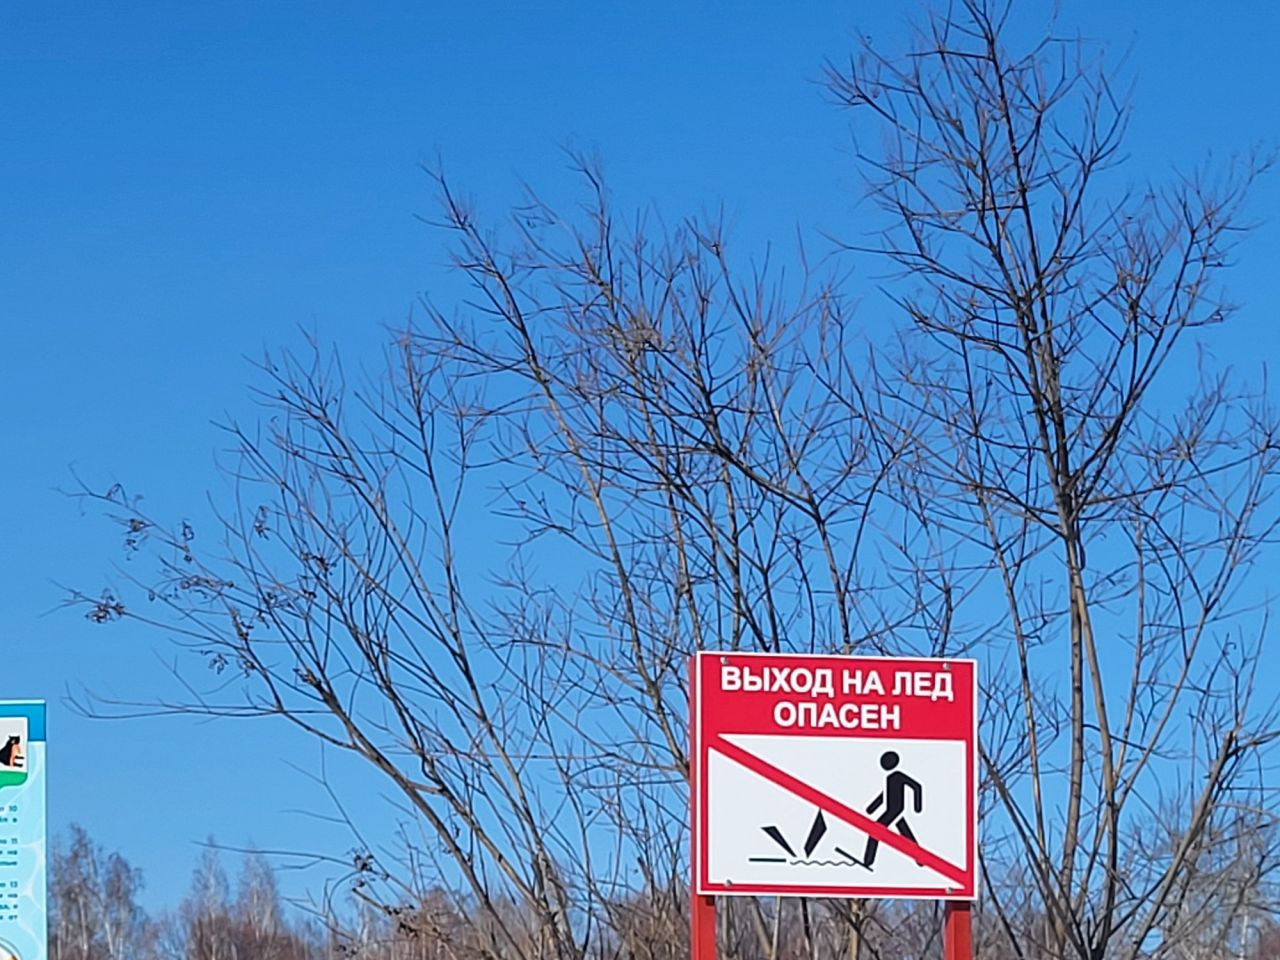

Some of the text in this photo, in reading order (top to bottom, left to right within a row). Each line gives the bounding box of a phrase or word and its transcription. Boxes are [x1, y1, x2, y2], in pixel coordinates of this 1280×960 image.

[721, 666, 954, 702] ВЫХОД НА ЛЕД
[773, 702, 901, 730] ОПАСЕН
